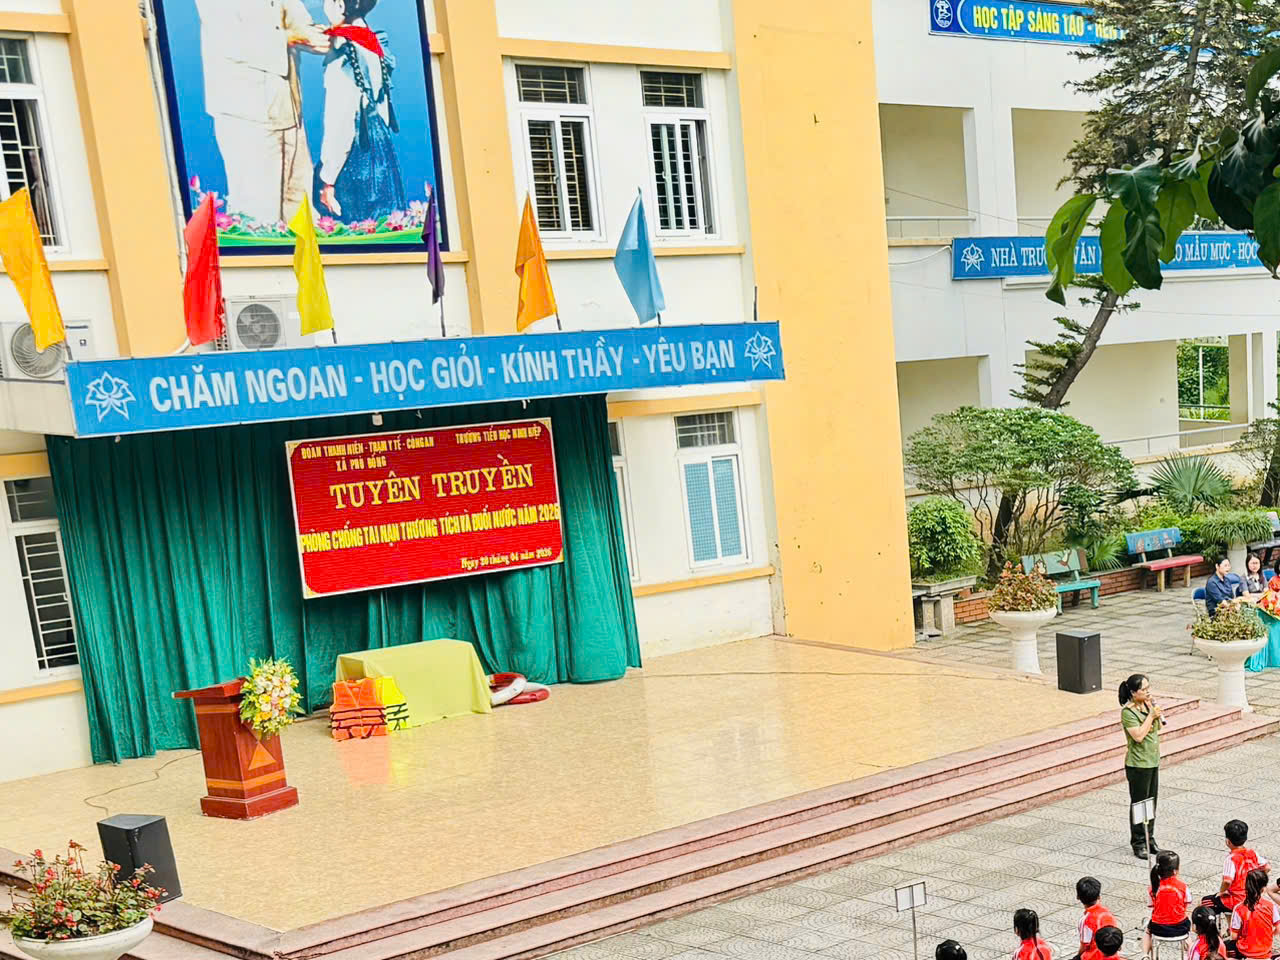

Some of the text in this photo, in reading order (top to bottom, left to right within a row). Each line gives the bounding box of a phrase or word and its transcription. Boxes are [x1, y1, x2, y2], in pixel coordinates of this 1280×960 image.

[973, 5, 998, 33] HỌC
[1001, 4, 1025, 35] TẬP
[1027, 8, 1060, 35] SÁNG
[1062, 13, 1085, 40] TẠO
[990, 241, 1018, 267] NHÀ
[1020, 243, 1048, 267] TRƯ
[1211, 242, 1232, 265] MỰC
[1237, 242, 1259, 265] HỌC
[149, 365, 240, 413] CHĂM
[244, 364, 347, 405] NGOAN
[369, 357, 425, 401] HỌC
[431, 342, 483, 390] GIỎI
[501, 344, 559, 385] KÍNH
[561, 336, 625, 380] THẦY
[642, 336, 687, 375] YÊU
[692, 339, 735, 376] BẠN
[329, 453, 534, 509] TUYÊN TRUYỀN
[299, 528, 331, 553] PHÒNG
[331, 520, 363, 550] CHỐNG
[363, 525, 380, 545] TAI
[380, 523, 400, 547] NẠN
[439, 511, 460, 536] TÍCH
[460, 509, 472, 533] VÀ
[492, 504, 517, 529] NƯỚC
[517, 503, 538, 526] NĂM
